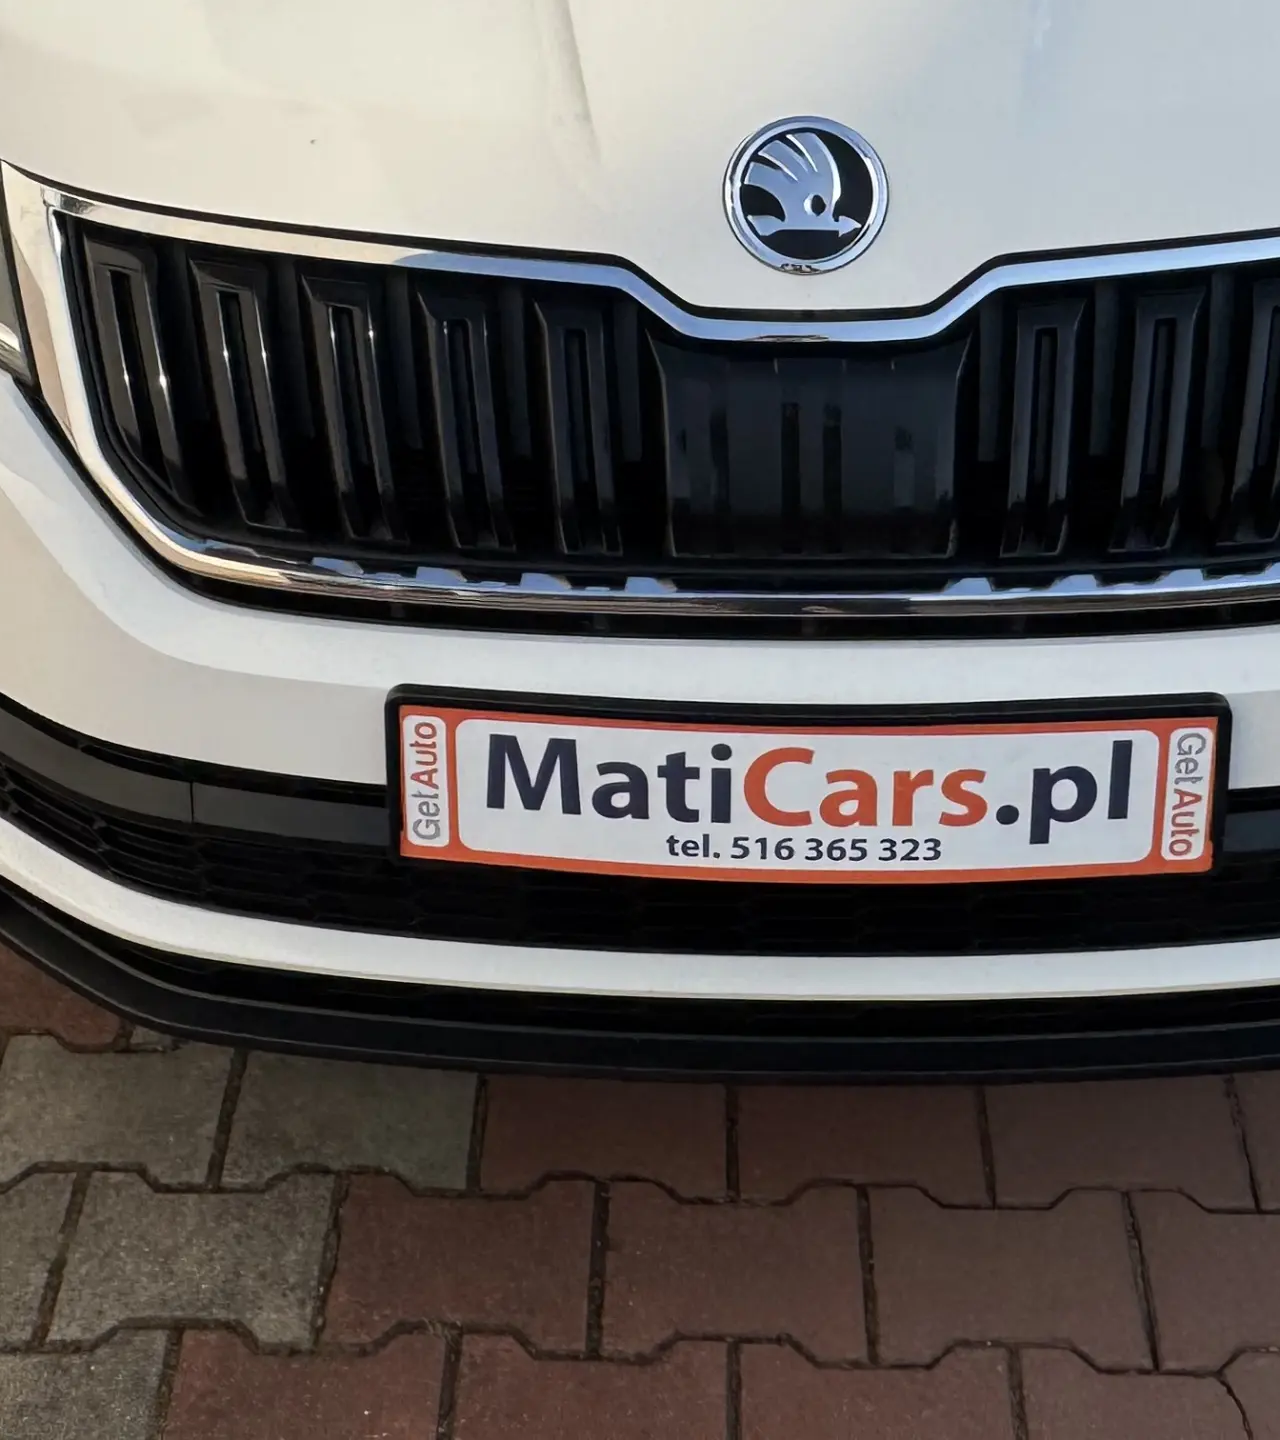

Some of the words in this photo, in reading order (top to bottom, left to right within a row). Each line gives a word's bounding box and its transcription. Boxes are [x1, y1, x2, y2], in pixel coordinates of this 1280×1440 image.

[486, 733, 1133, 845] MatiCars.pl
[666, 833, 721, 859] tel.
[730, 836, 795, 861] 516
[804, 837, 868, 861] 365
[878, 837, 942, 861] 323
